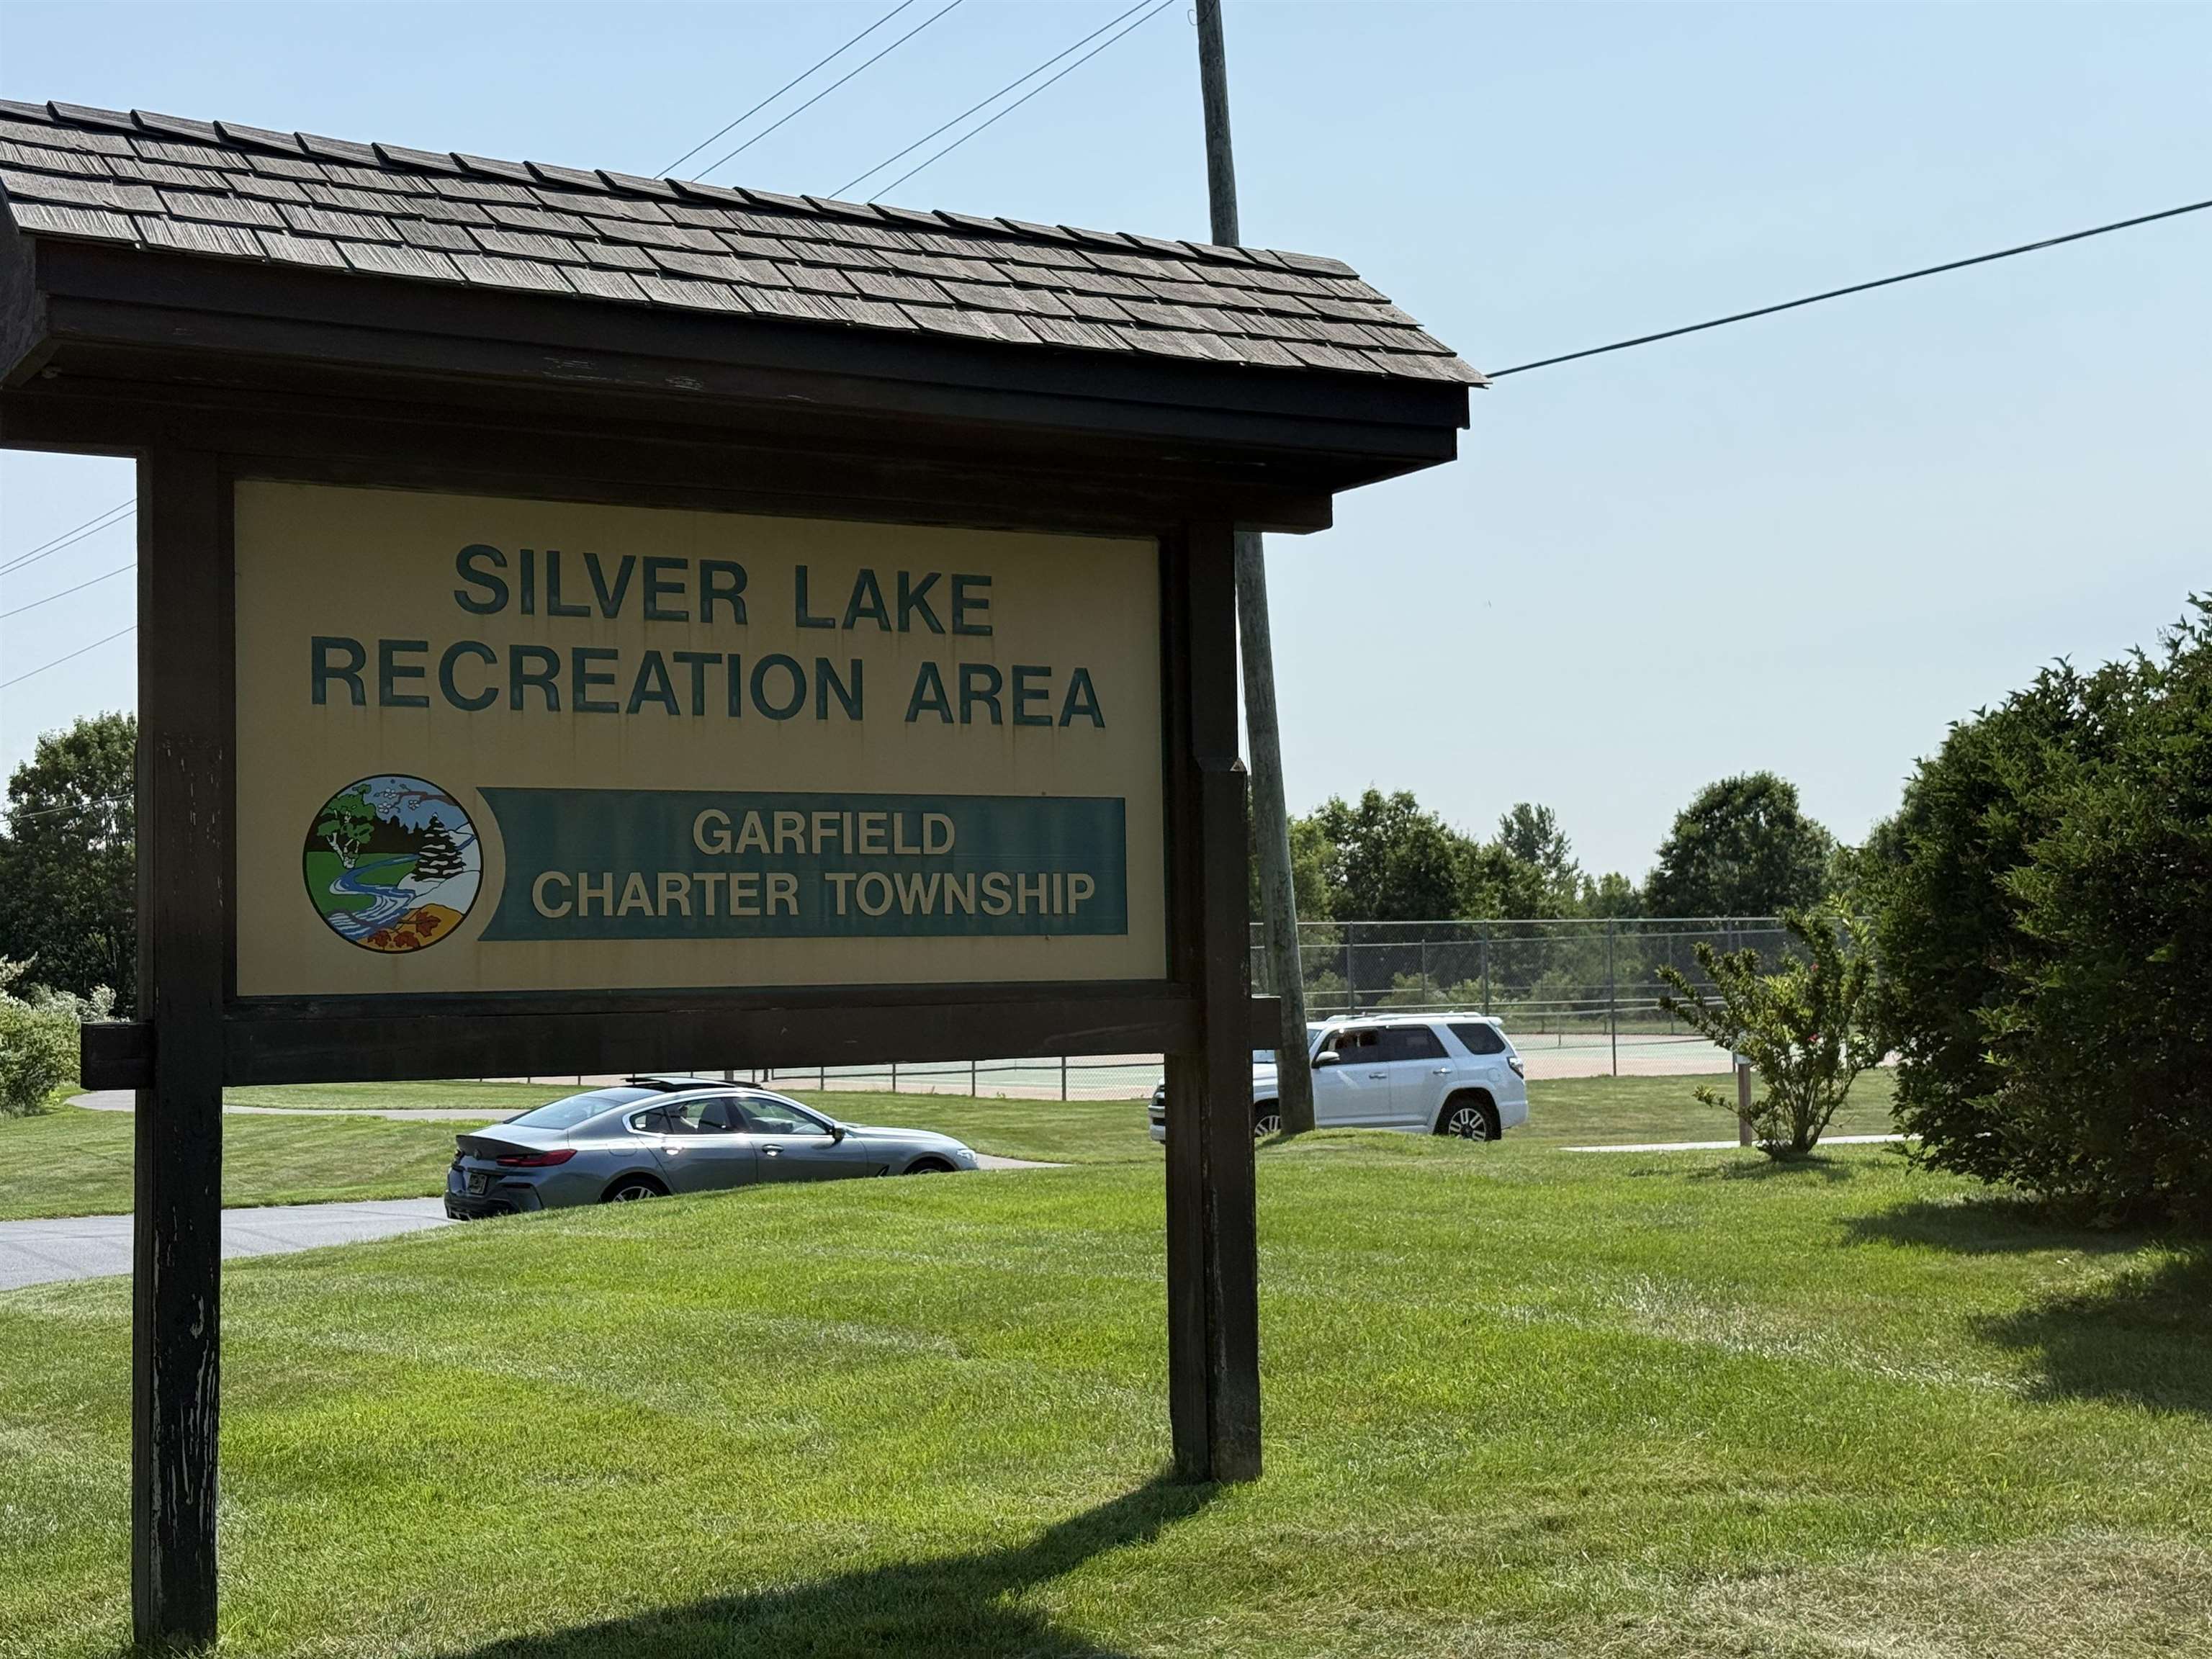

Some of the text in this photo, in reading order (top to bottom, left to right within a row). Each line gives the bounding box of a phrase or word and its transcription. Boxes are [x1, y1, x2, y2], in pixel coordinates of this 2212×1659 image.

[454, 544, 993, 637] SILVER LAKE
[311, 636, 1106, 729] RECREATION AREA
[692, 808, 956, 855] GARFIELD
[531, 871, 1095, 918] CHARTER TOWNSHIP
